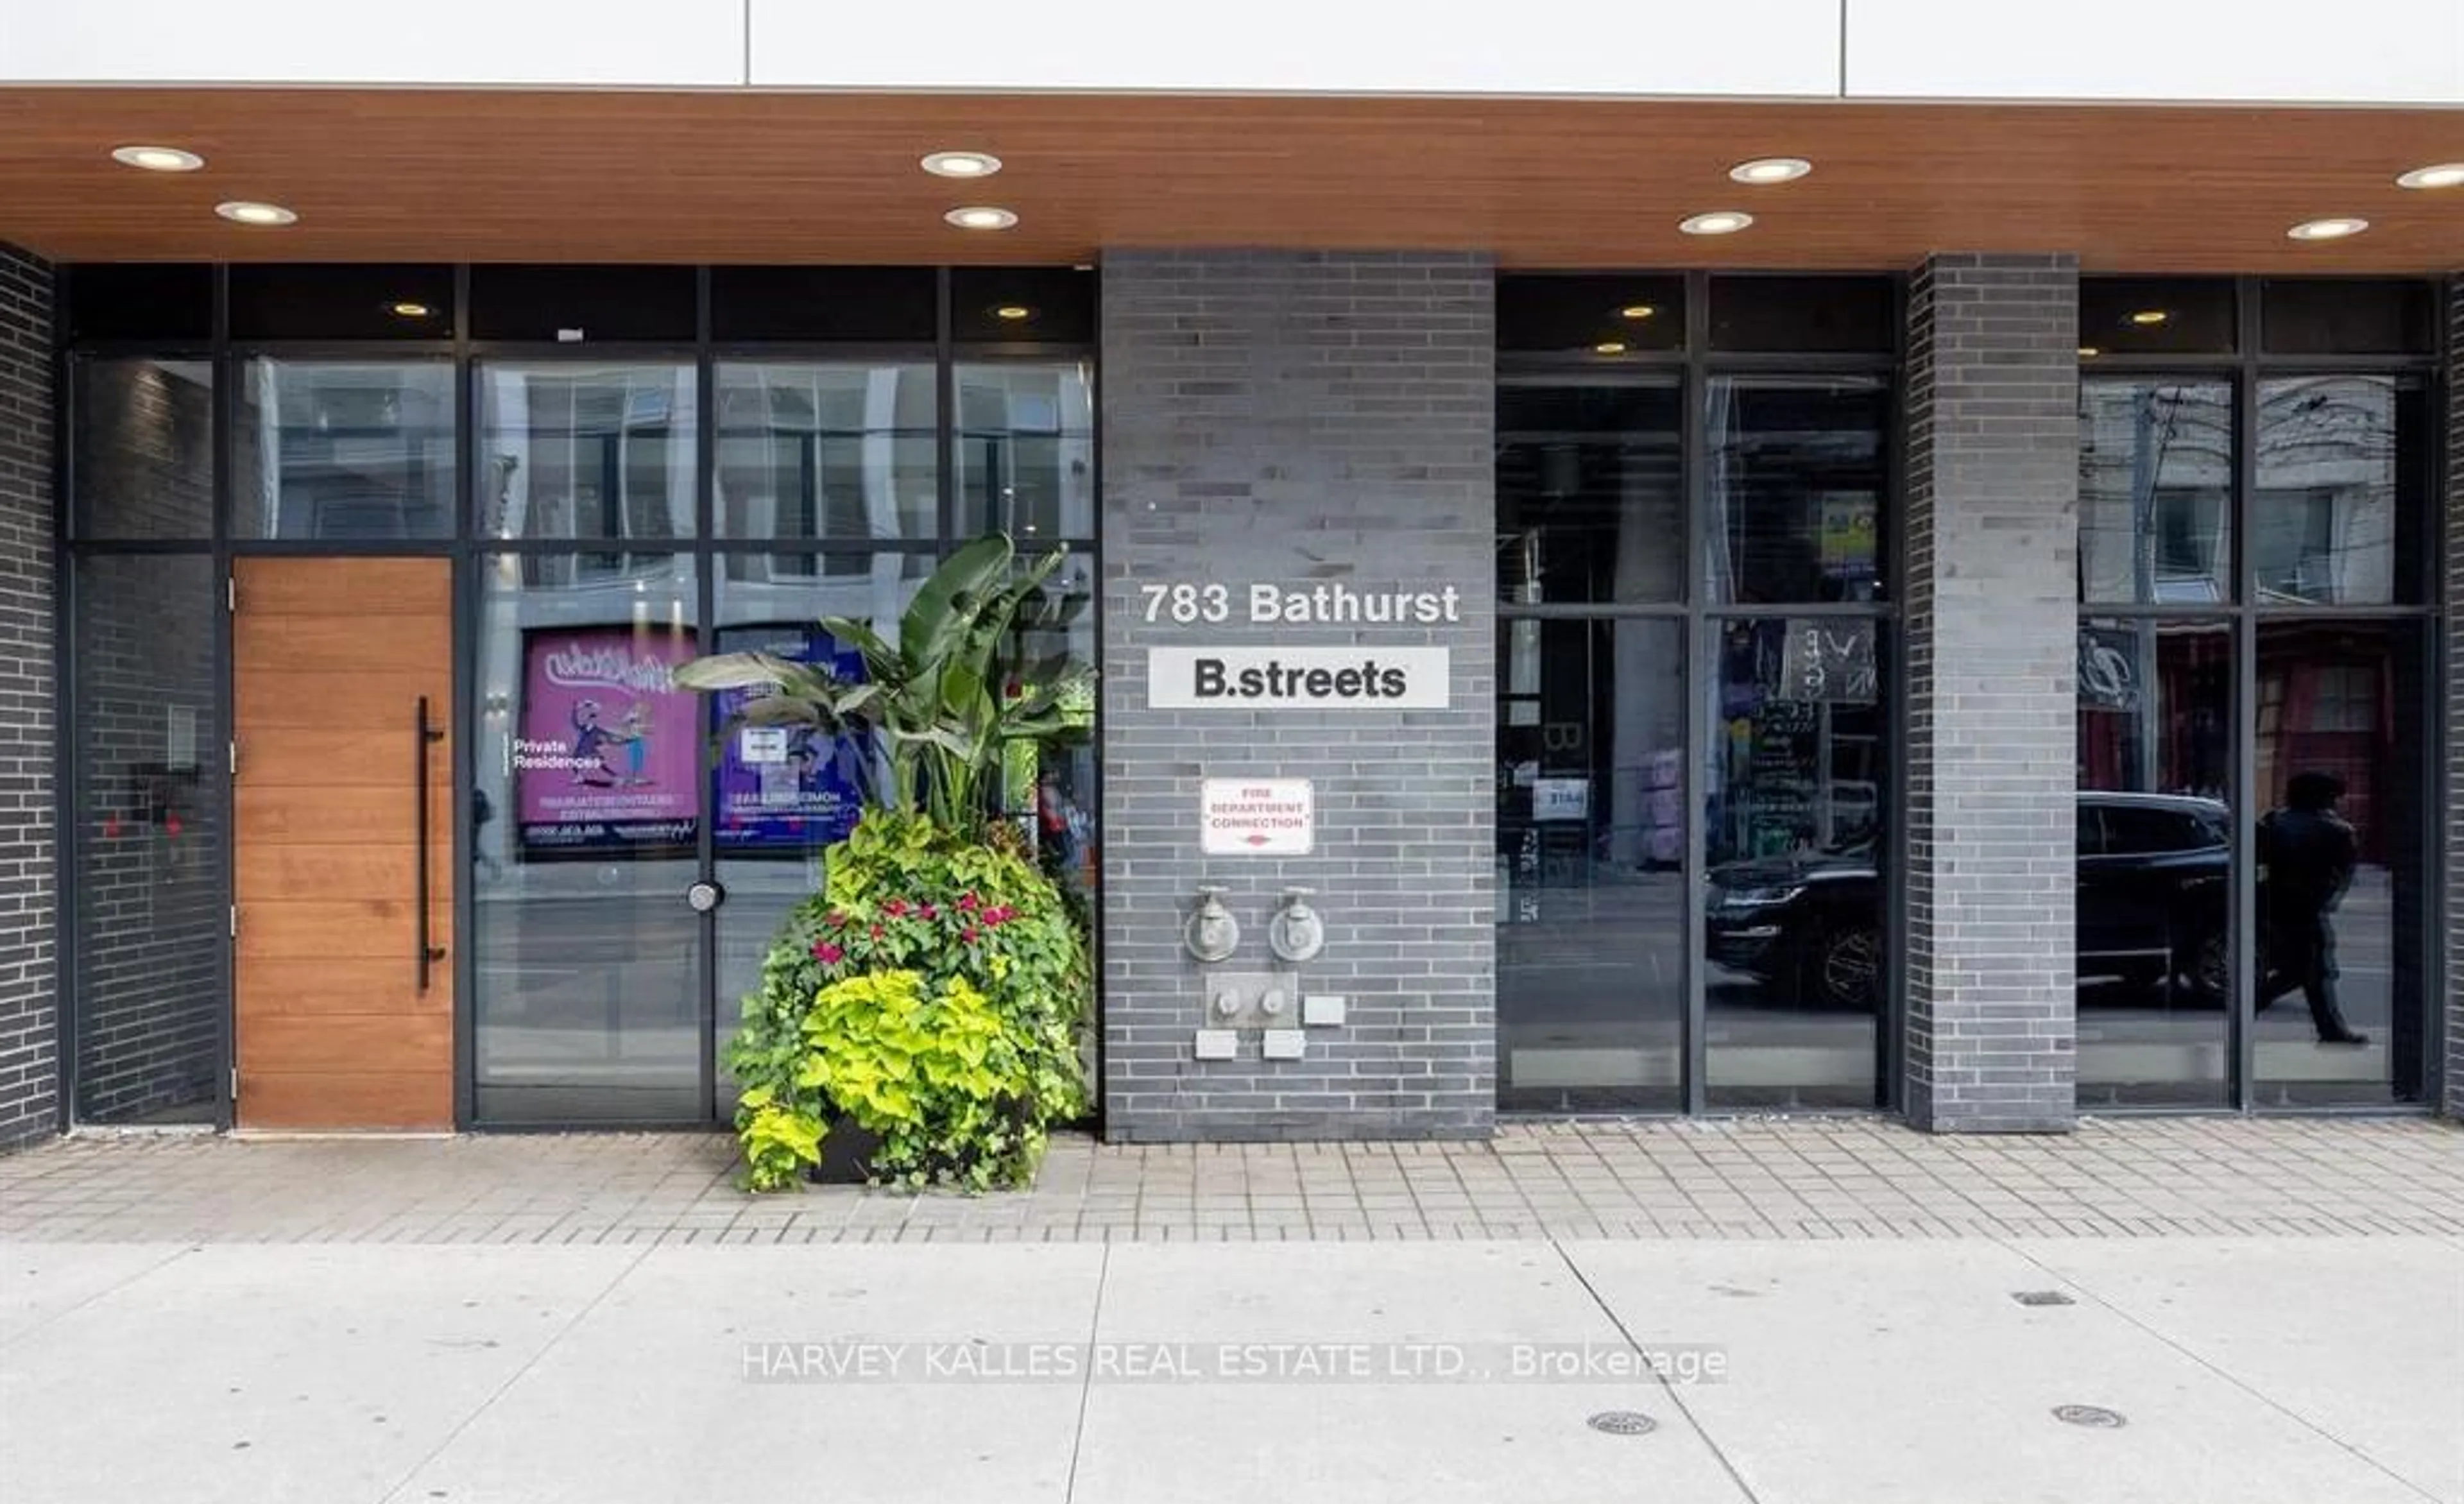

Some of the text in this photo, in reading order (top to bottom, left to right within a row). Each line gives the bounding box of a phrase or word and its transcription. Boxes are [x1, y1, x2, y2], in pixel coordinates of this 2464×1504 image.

[1142, 584, 1460, 622] 783 Bathurst
[1194, 658, 1406, 698] B.streets
[513, 739, 567, 752] Private
[513, 755, 601, 769] Residences
[1242, 789, 1271, 798] FIRE
[1210, 803, 1303, 814] DEPARTMENT
[1211, 817, 1303, 828] CONNECTION
